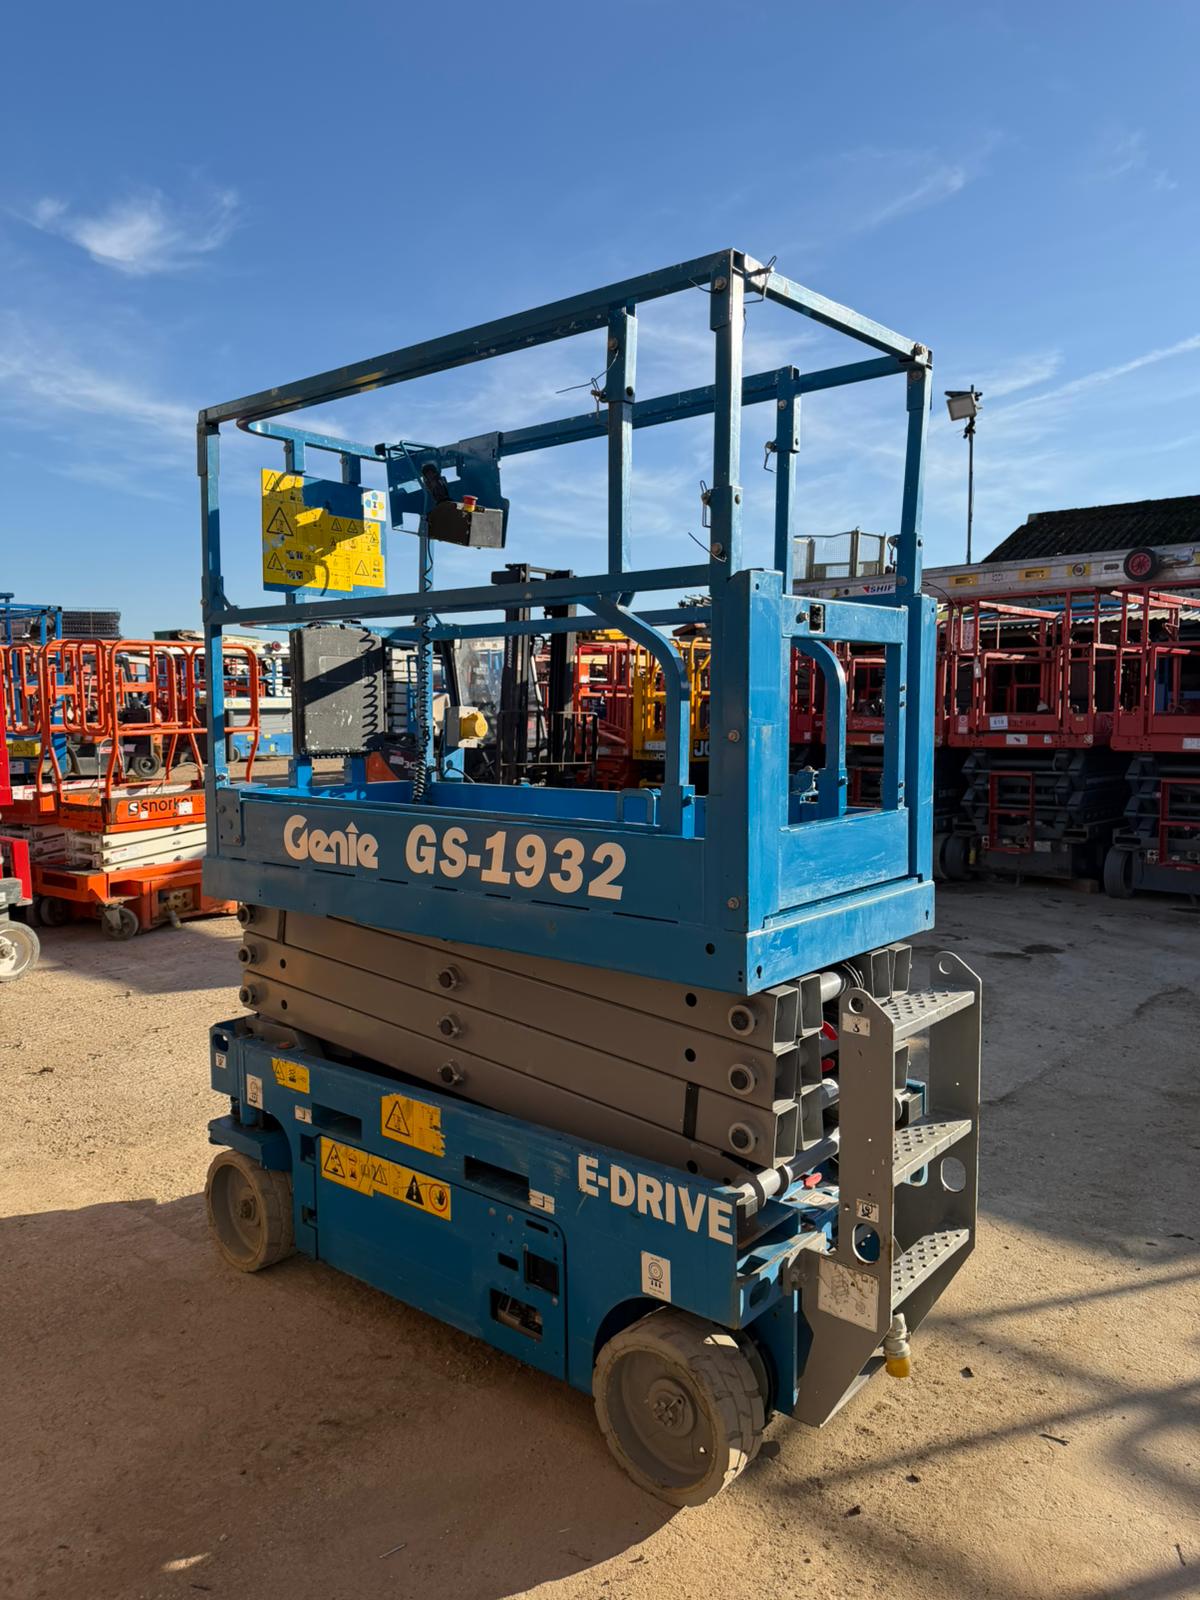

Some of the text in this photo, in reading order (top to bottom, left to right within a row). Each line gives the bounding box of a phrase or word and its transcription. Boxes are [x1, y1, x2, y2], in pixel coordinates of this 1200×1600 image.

[283, 814, 626, 900] Genie GS-1932
[578, 1153, 733, 1245] E-DRIVE
